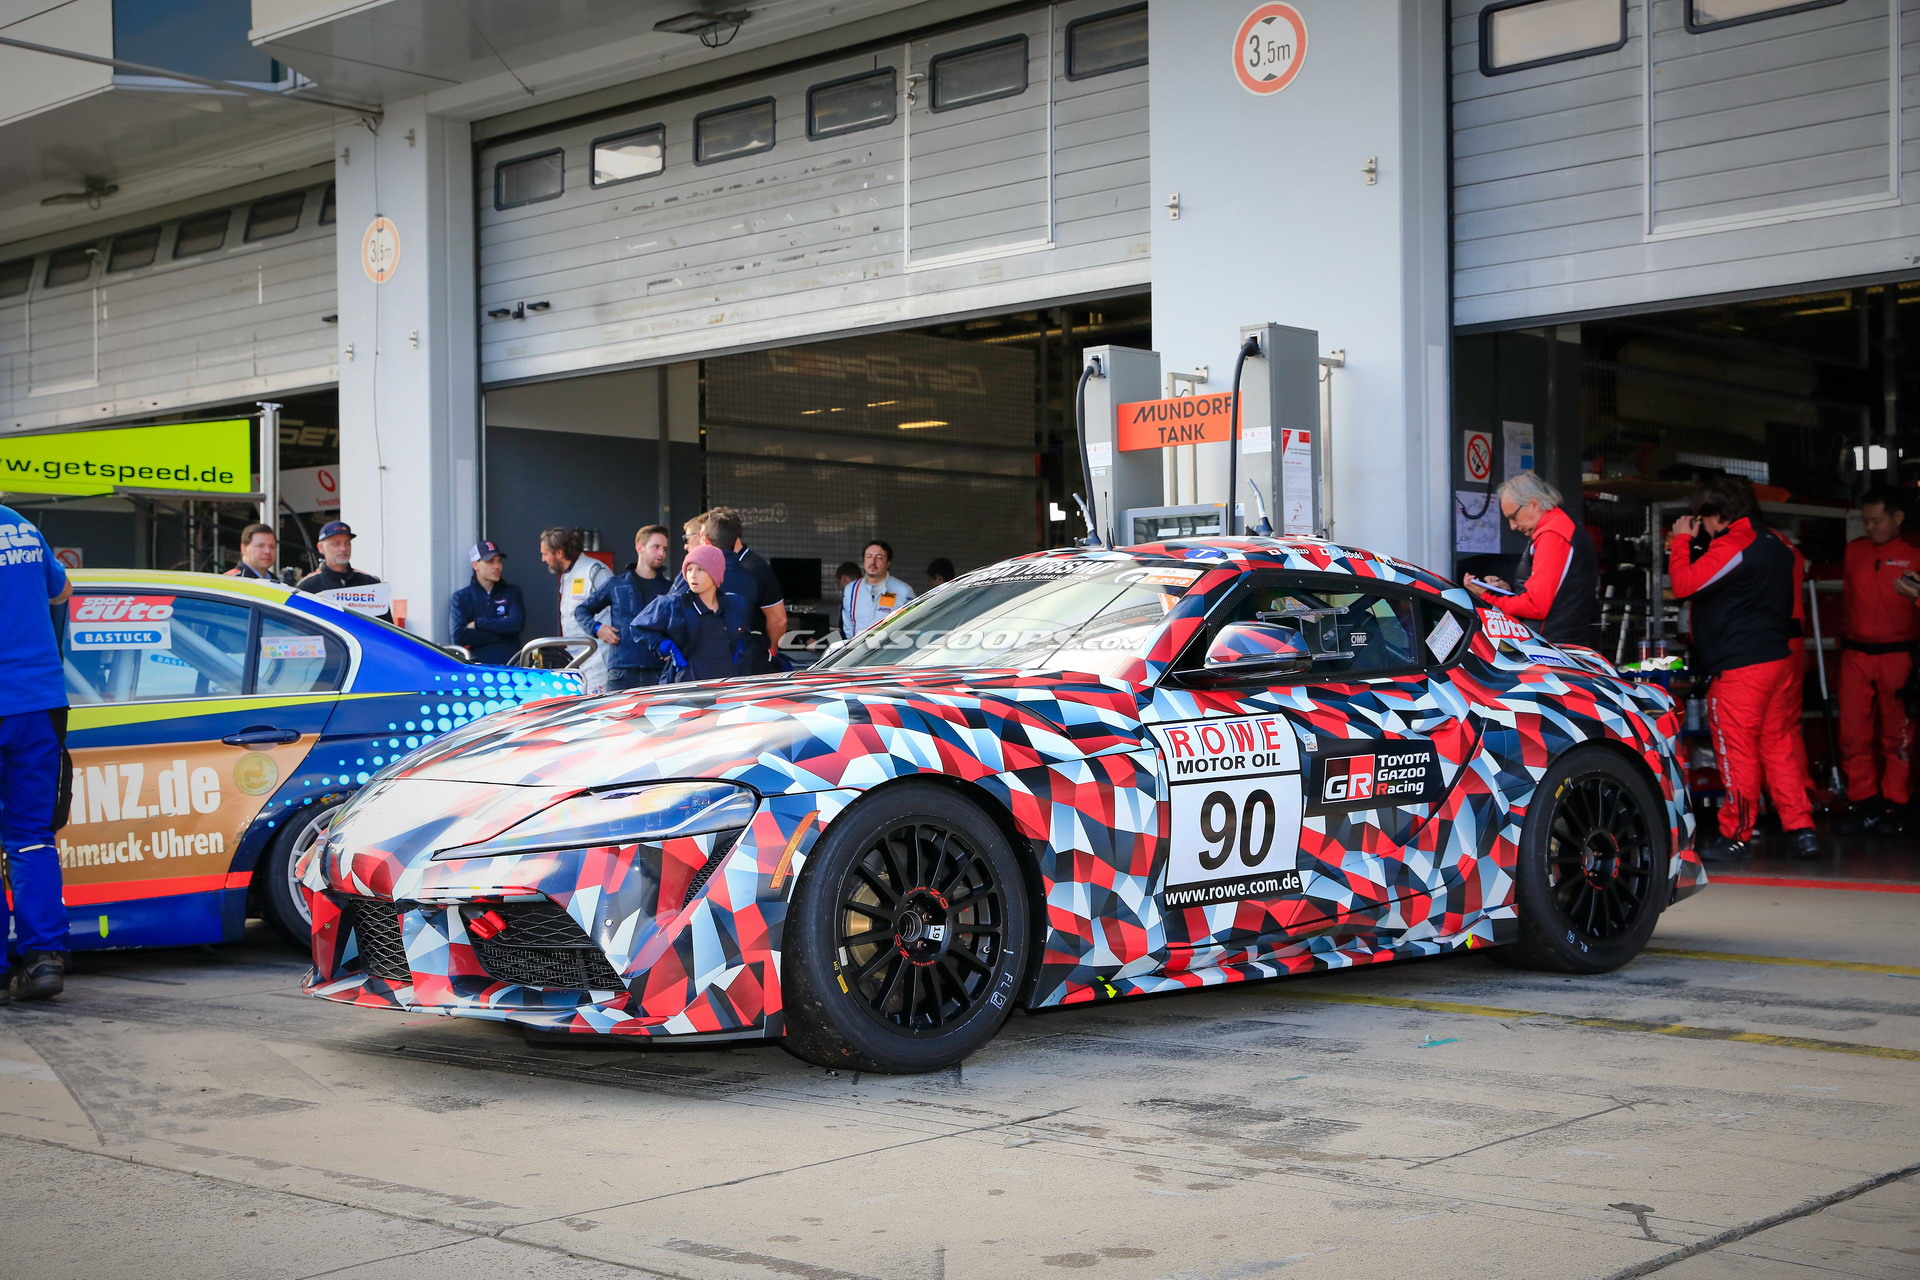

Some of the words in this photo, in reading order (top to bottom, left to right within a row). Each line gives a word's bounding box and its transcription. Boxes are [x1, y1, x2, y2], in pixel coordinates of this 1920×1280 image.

[1158, 423, 1205, 444] TANK
[0, 457, 234, 484] w.getspeed.de
[82, 596, 136, 607] sport
[336, 592, 375, 602] HUBER
[75, 602, 175, 621] auto
[1483, 609, 1507, 621] sport
[84, 632, 153, 643] BASTUCK
[1350, 634, 1367, 644] OMP
[1486, 619, 1531, 639] auto
[1165, 719, 1281, 759] ROWE
[1176, 755, 1246, 775] MOTOR
[1251, 752, 1281, 768] OIL
[1324, 772, 1373, 800] GR
[1375, 780, 1425, 796] Racing
[1198, 788, 1276, 871] 90
[1165, 872, 1300, 906] www.rowe.com.de
